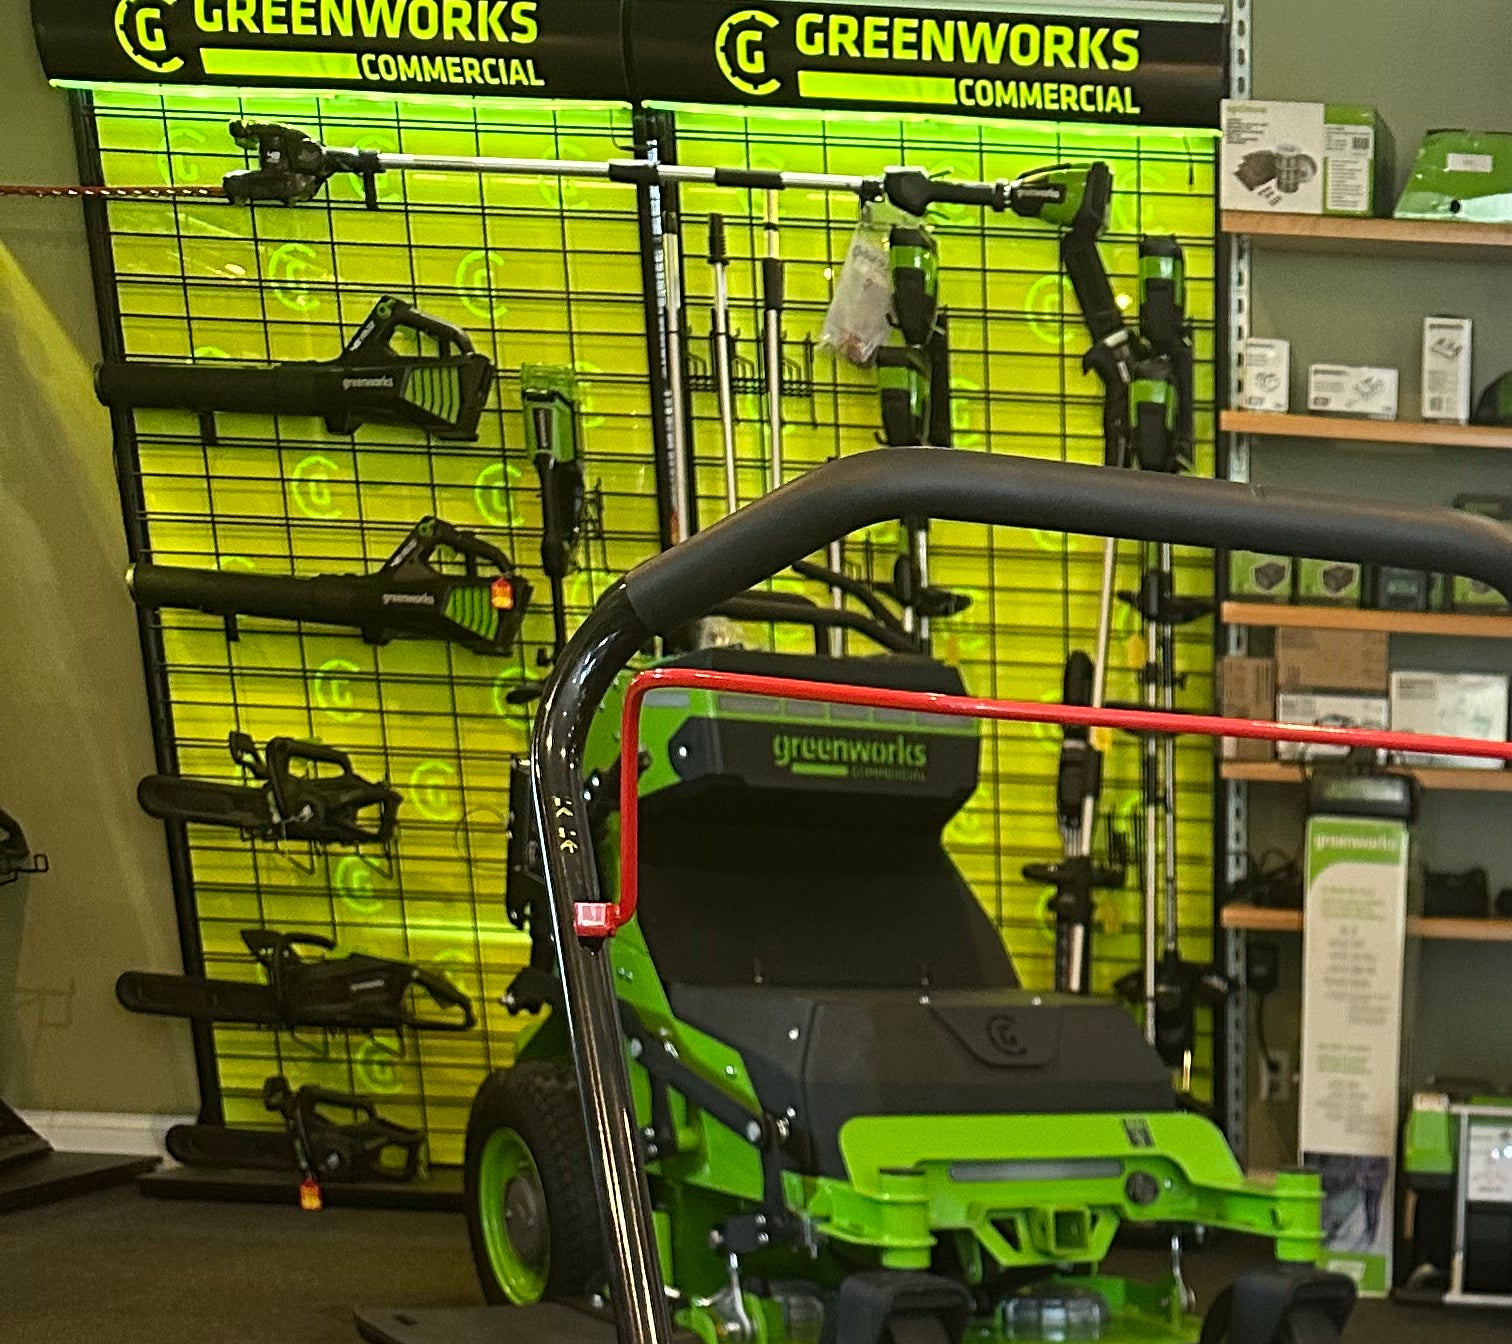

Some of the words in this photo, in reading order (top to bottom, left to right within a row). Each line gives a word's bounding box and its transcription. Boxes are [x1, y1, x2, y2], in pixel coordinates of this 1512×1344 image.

[195, 0, 538, 43] GREENWORKS
[796, 15, 1140, 72] GREENWORKS
[361, 53, 545, 87] COMMERCIAL
[959, 78, 1140, 114] COMMERCIAL
[774, 735, 927, 767] greenworks
